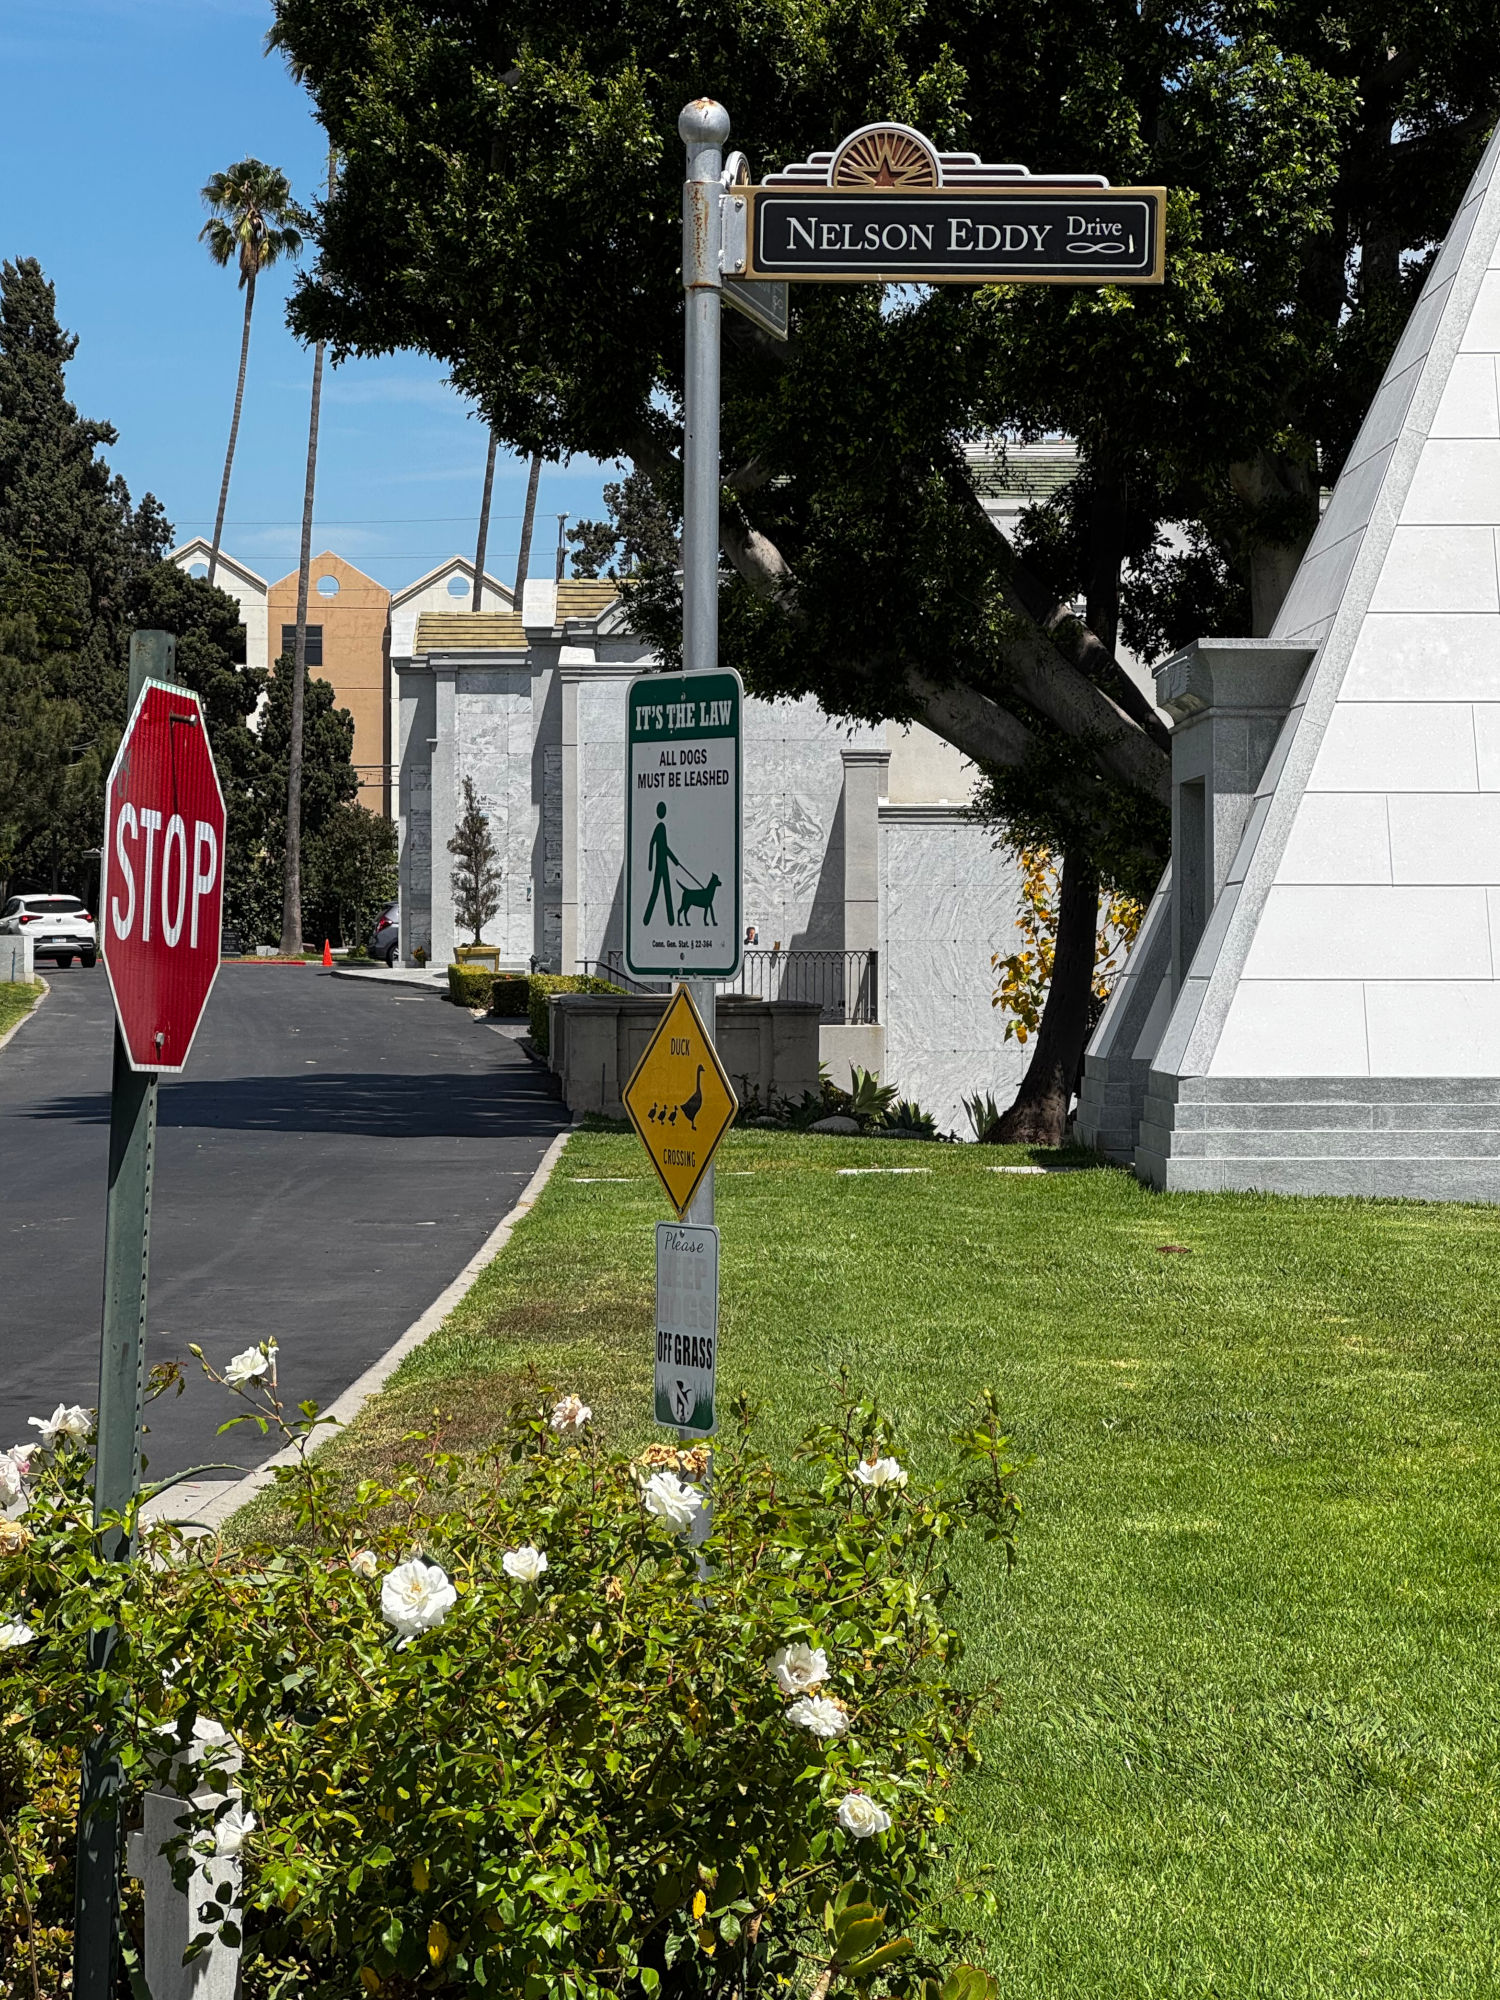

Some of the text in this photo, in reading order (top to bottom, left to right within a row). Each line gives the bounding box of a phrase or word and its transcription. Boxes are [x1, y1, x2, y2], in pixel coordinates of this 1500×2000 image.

[786, 215, 1123, 251] NELSON EDDY Drive
[635, 700, 732, 731] IT'S THE LAW
[659, 748, 708, 767] ALL DOGS
[637, 769, 729, 789] MUST BE LEASHED
[111, 802, 217, 949] STOP
[666, 940, 677, 948] Gen.
[678, 940, 690, 948] Stat.
[670, 1038, 690, 1056] DUCK
[663, 1148, 696, 1168] CROSSING
[664, 1231, 705, 1253] Please
[657, 1331, 713, 1370] OFF GRASS
